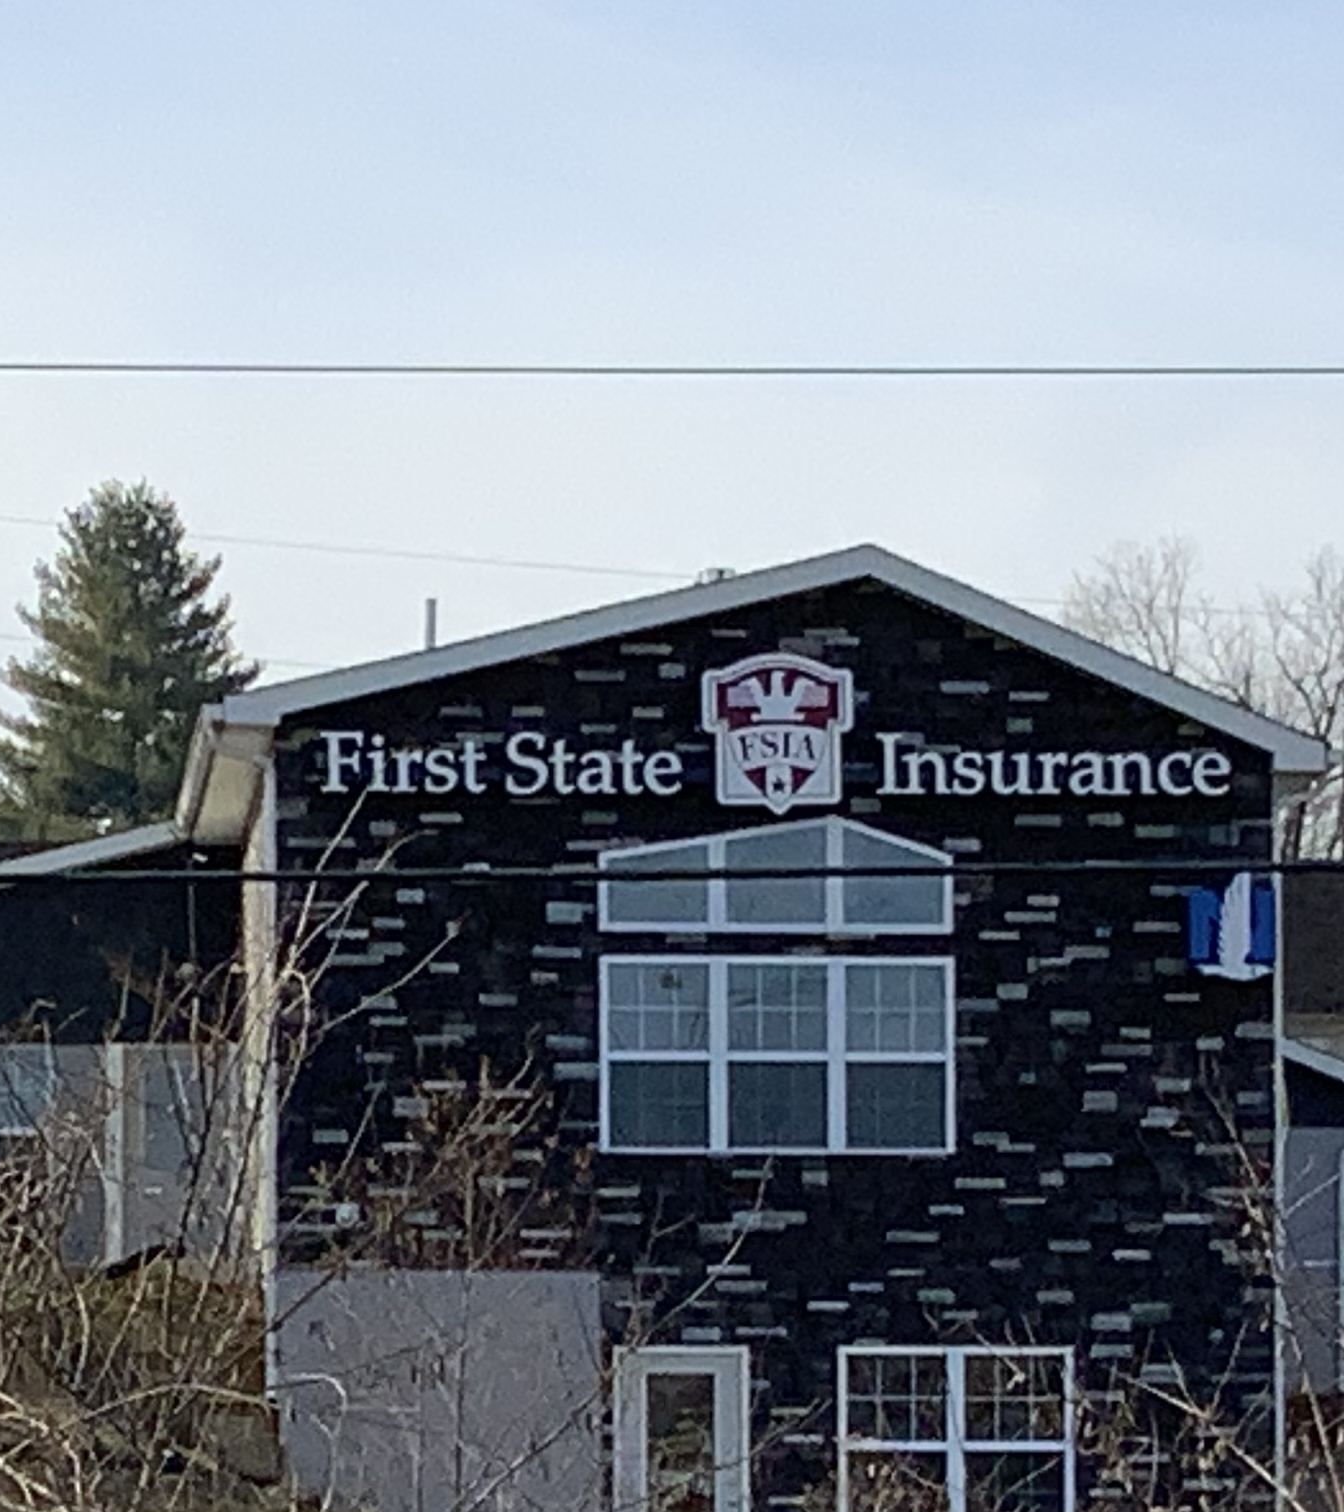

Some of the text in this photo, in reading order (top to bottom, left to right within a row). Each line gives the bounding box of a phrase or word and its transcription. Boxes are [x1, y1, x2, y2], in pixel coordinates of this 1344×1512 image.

[319, 730, 1232, 796] First State Insurance
[737, 731, 816, 761] FSIA
